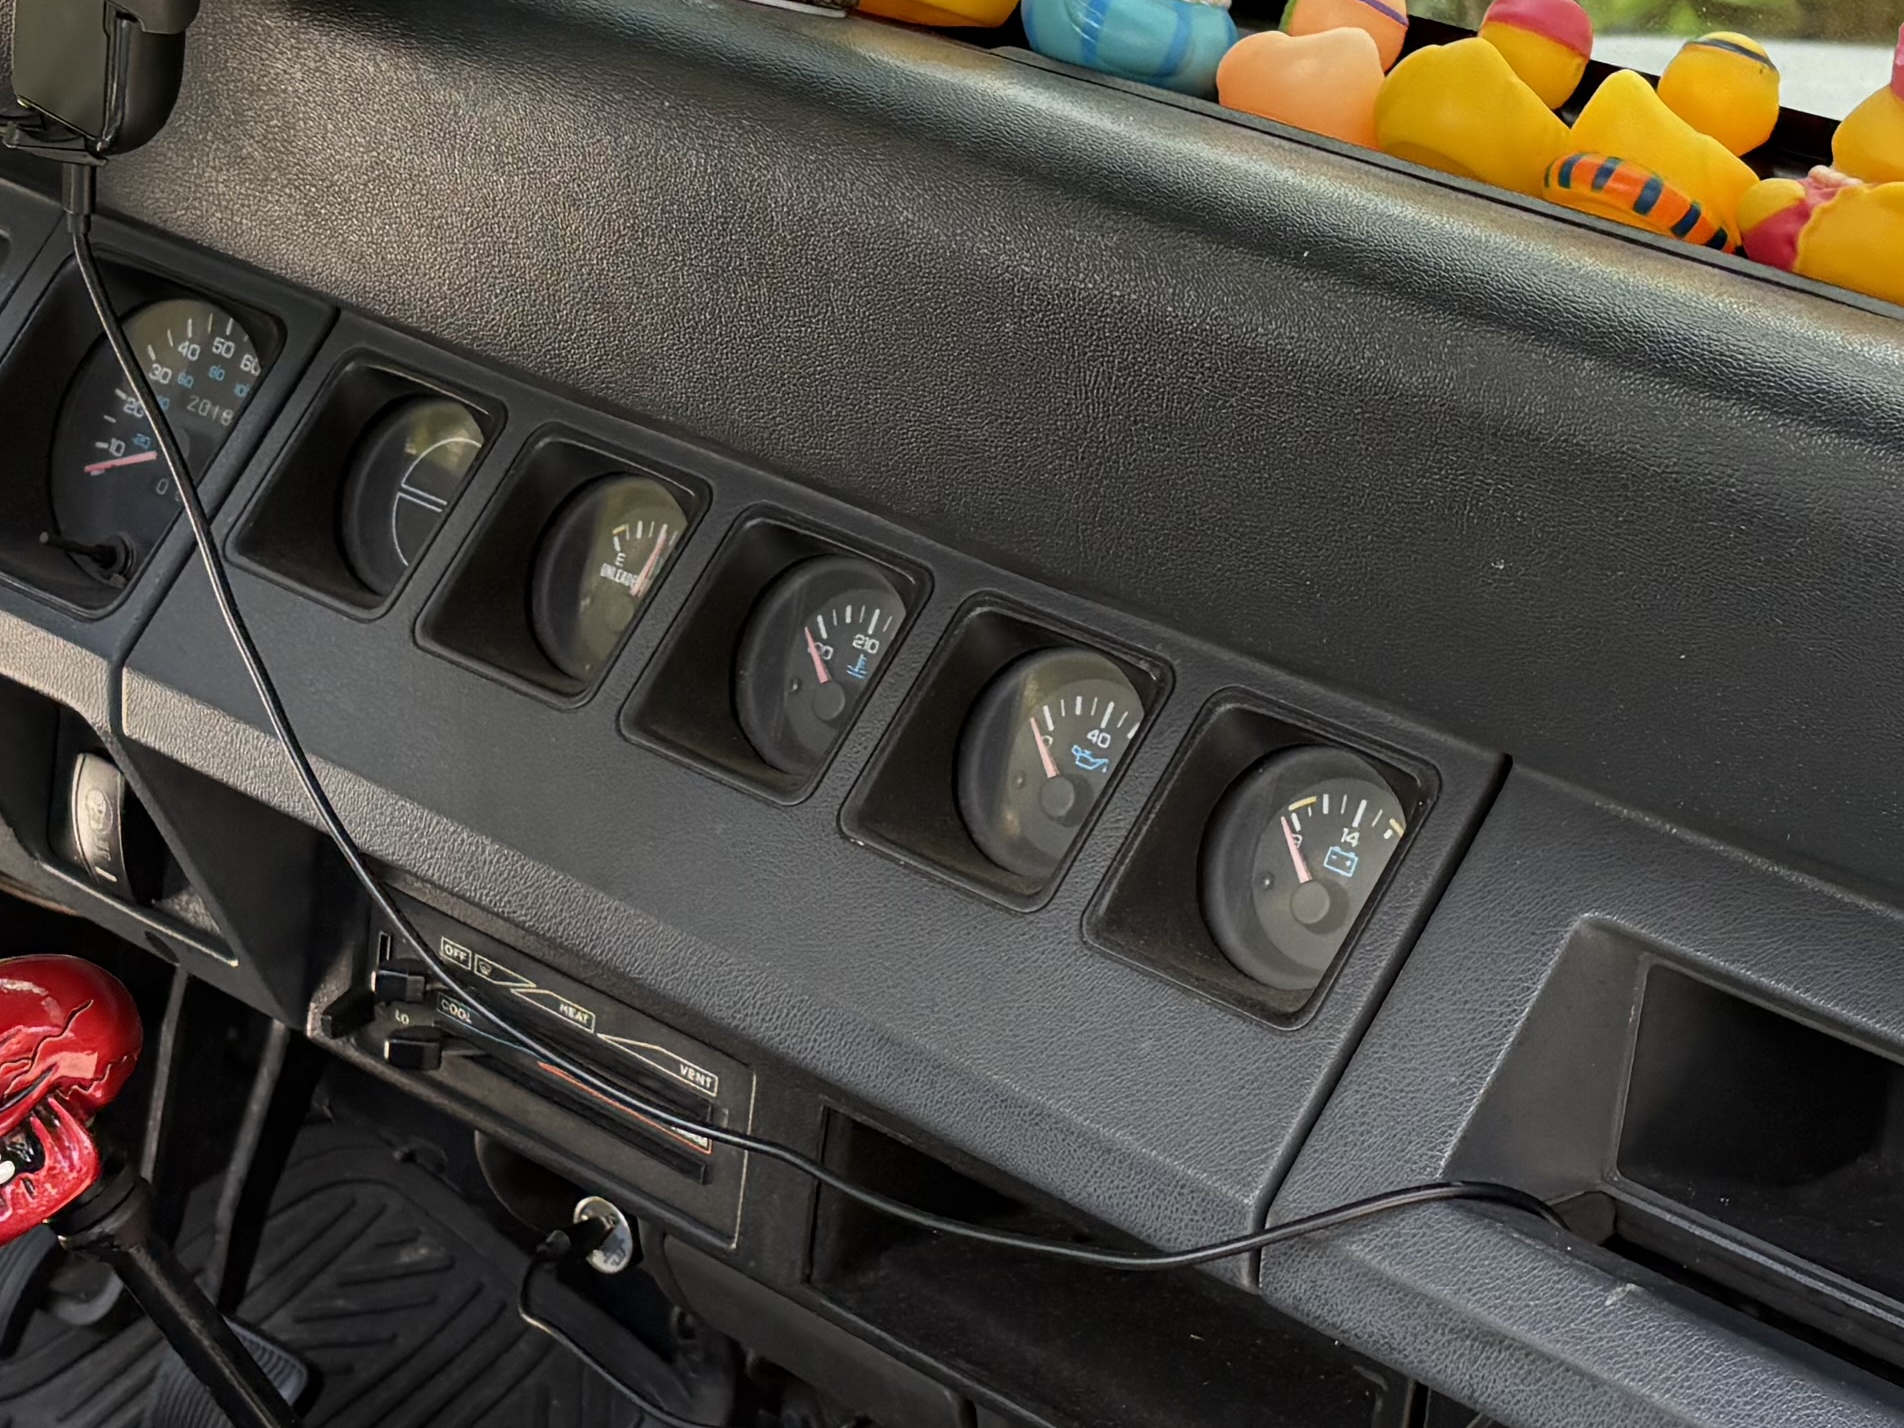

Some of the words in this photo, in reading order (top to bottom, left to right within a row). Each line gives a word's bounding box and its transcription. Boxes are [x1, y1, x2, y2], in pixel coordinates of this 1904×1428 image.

[178, 341, 201, 361] 40
[212, 337, 236, 359] 50
[148, 363, 173, 385] 30
[240, 353, 262, 376] 60
[123, 397, 145, 418] 20
[109, 437, 126, 458] 10
[615, 552, 627, 568] E
[852, 633, 880, 655] 210
[1087, 729, 1111, 749] 40
[1340, 827, 1360, 848] 14
[444, 943, 468, 962] OFF
[394, 1008, 410, 1025] LO
[440, 998, 473, 1025] COOL
[558, 1003, 589, 1025] HEAT
[679, 1062, 713, 1089] VENT
